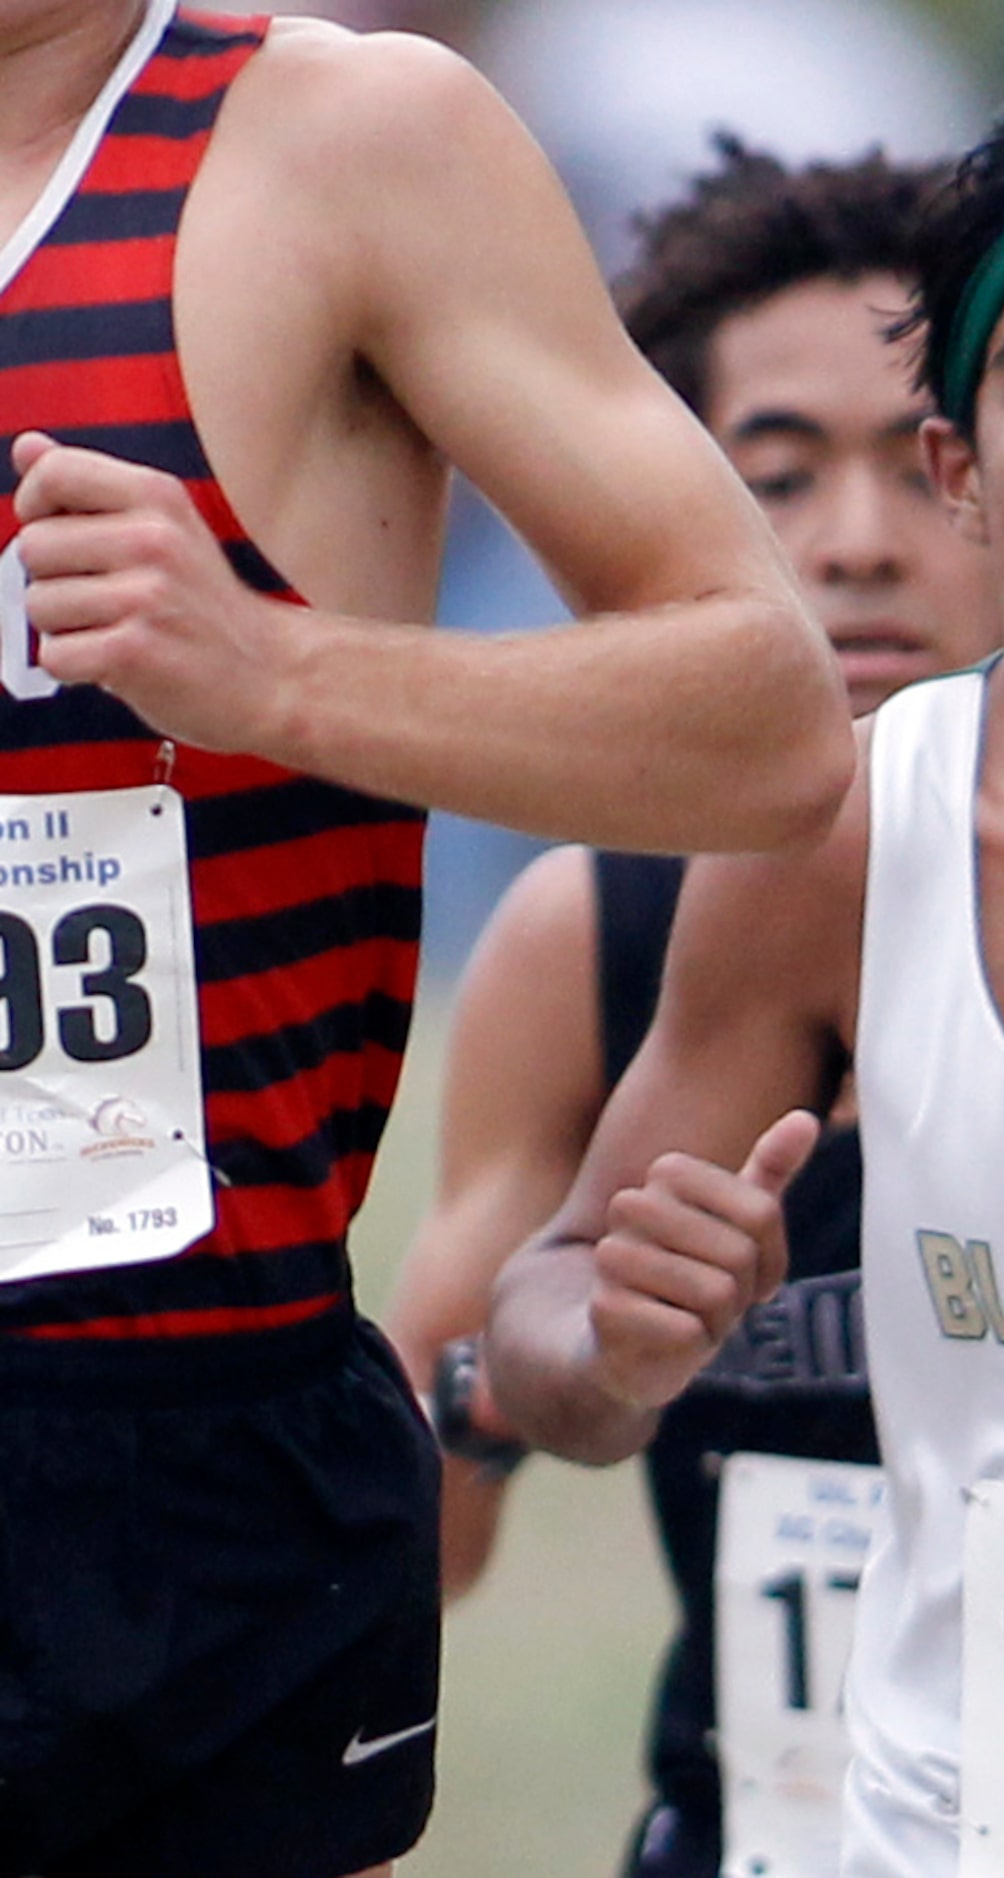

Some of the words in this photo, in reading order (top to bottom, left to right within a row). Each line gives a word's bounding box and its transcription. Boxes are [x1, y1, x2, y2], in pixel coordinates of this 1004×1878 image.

[45, 810, 69, 839] II
[87, 1215, 120, 1236] No.
[128, 1207, 178, 1232] 1793
